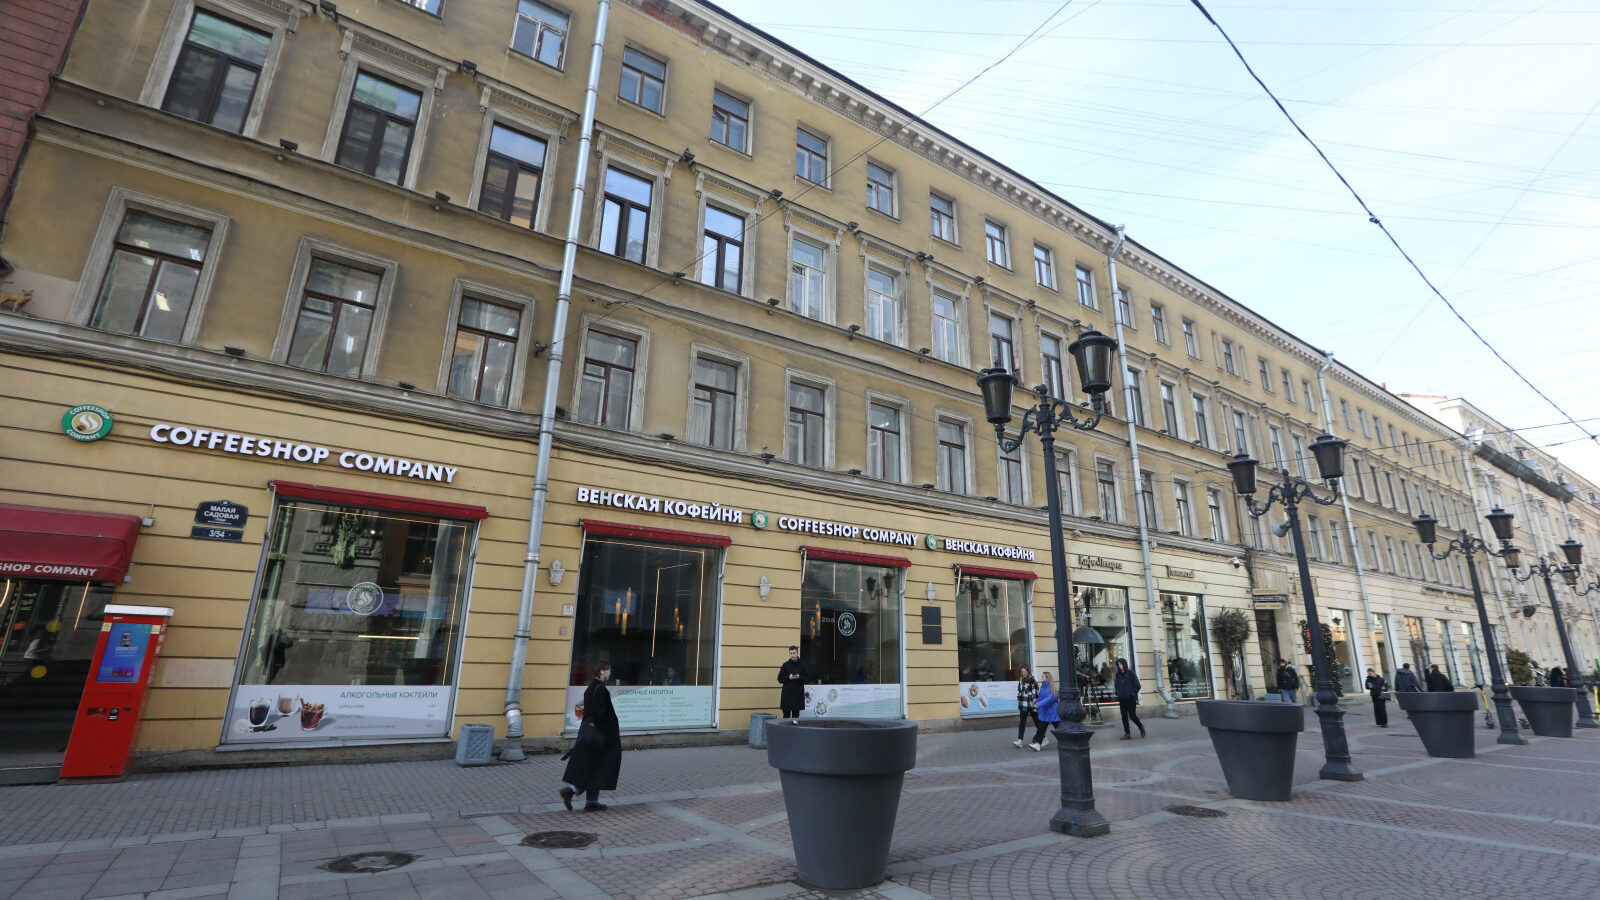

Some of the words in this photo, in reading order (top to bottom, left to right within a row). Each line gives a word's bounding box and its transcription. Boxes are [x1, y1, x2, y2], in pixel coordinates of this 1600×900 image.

[70, 405, 110, 420] COFFEESHOP
[66, 429, 101, 440] COMPANY
[150, 423, 330, 464] COFFEESHOP
[339, 451, 458, 483] COMPANY
[210, 505, 237, 514] МАЛАЯ
[577, 486, 660, 513] ВЕНСКАЯ
[663, 499, 743, 524] КОФЕЙНЯ
[203, 510, 240, 520] САДОВАЯ
[208, 529, 226, 538] 3/54
[778, 516, 860, 538] COFFEESHOP
[862, 527, 919, 546] COMPANY
[944, 538, 990, 556] ВЕНСКАЯ
[991, 546, 1035, 561] КОФЕЙНЯ
[33, 565, 98, 577] COMPANY
[340, 691, 398, 699] АЛКОГОЛЬНЫЕ
[399, 690, 438, 699] КОКТЕЙЛИ
